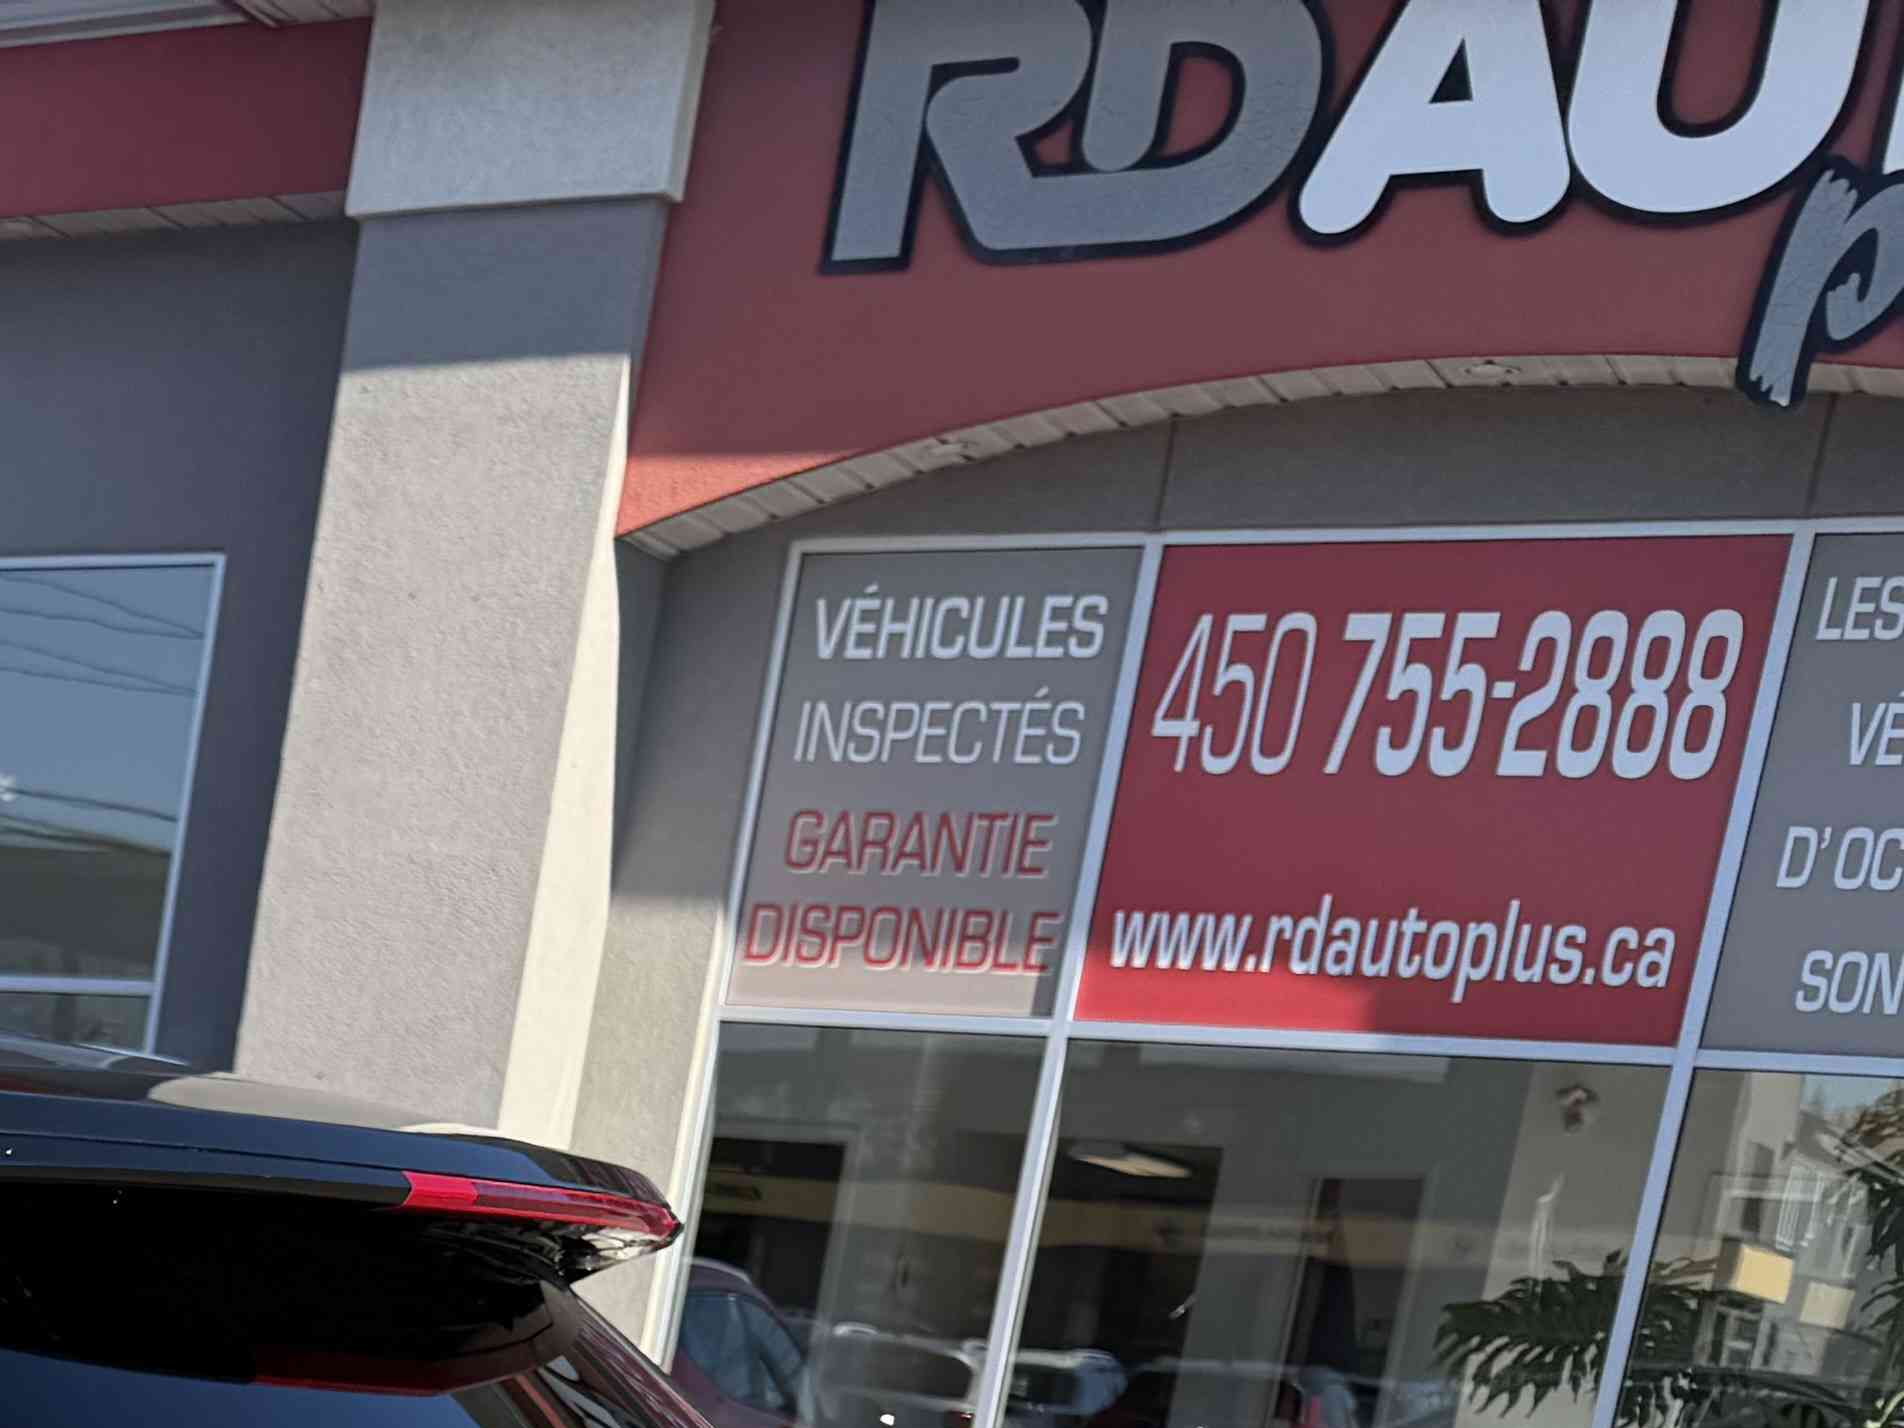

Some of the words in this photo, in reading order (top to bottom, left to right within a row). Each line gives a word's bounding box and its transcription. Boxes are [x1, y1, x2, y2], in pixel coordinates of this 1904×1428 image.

[822, 0, 1904, 272] RDAU
[816, 583, 1109, 661] VÉHICULES
[794, 686, 1085, 765] INSPECTÉS
[1150, 611, 1317, 776] 450
[1323, 608, 1745, 781] 755-2888
[784, 809, 1059, 880] GARANTIE
[742, 902, 1064, 975] DISPONIBLE
[1110, 893, 1677, 1004] www.rdautoplus.ca
